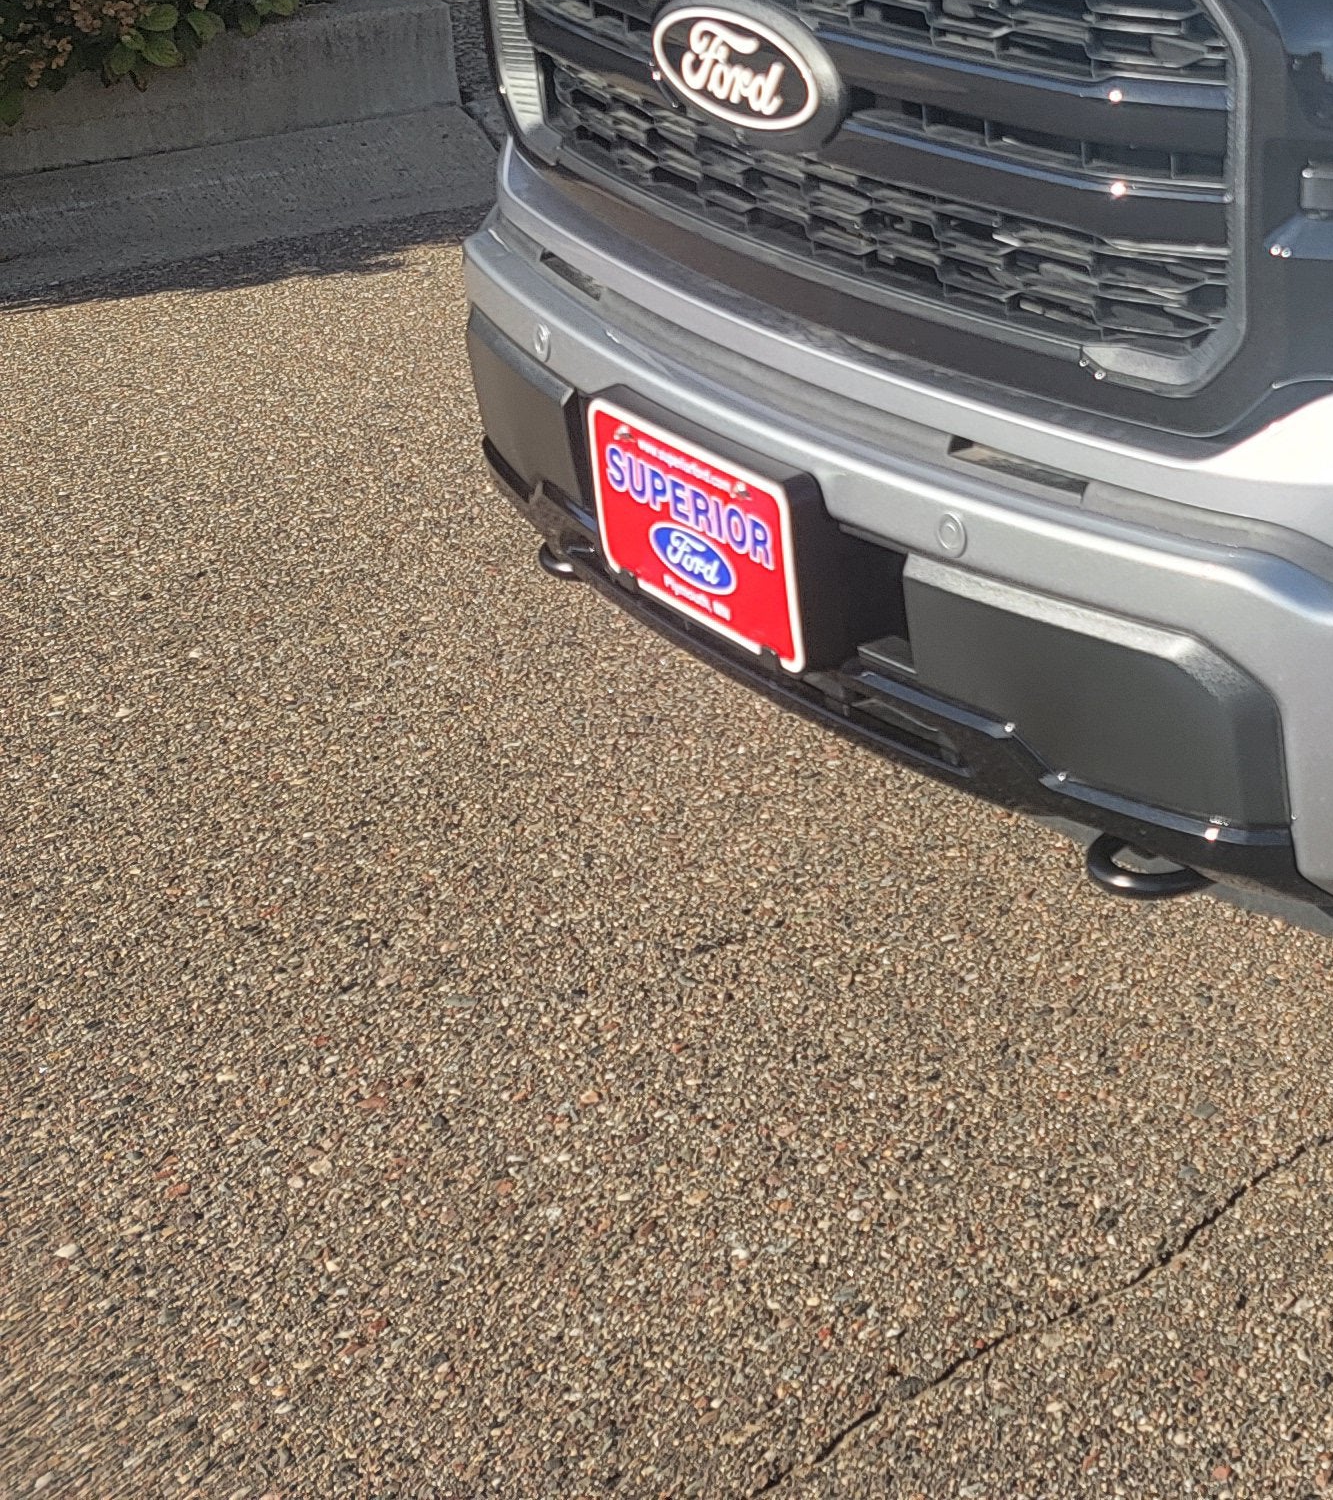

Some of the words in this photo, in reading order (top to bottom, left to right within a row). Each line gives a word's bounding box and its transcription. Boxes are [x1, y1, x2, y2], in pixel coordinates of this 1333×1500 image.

[681, 19, 785, 116] Ford
[606, 444, 775, 571] SUPERIOR
[666, 530, 720, 585] Ford
